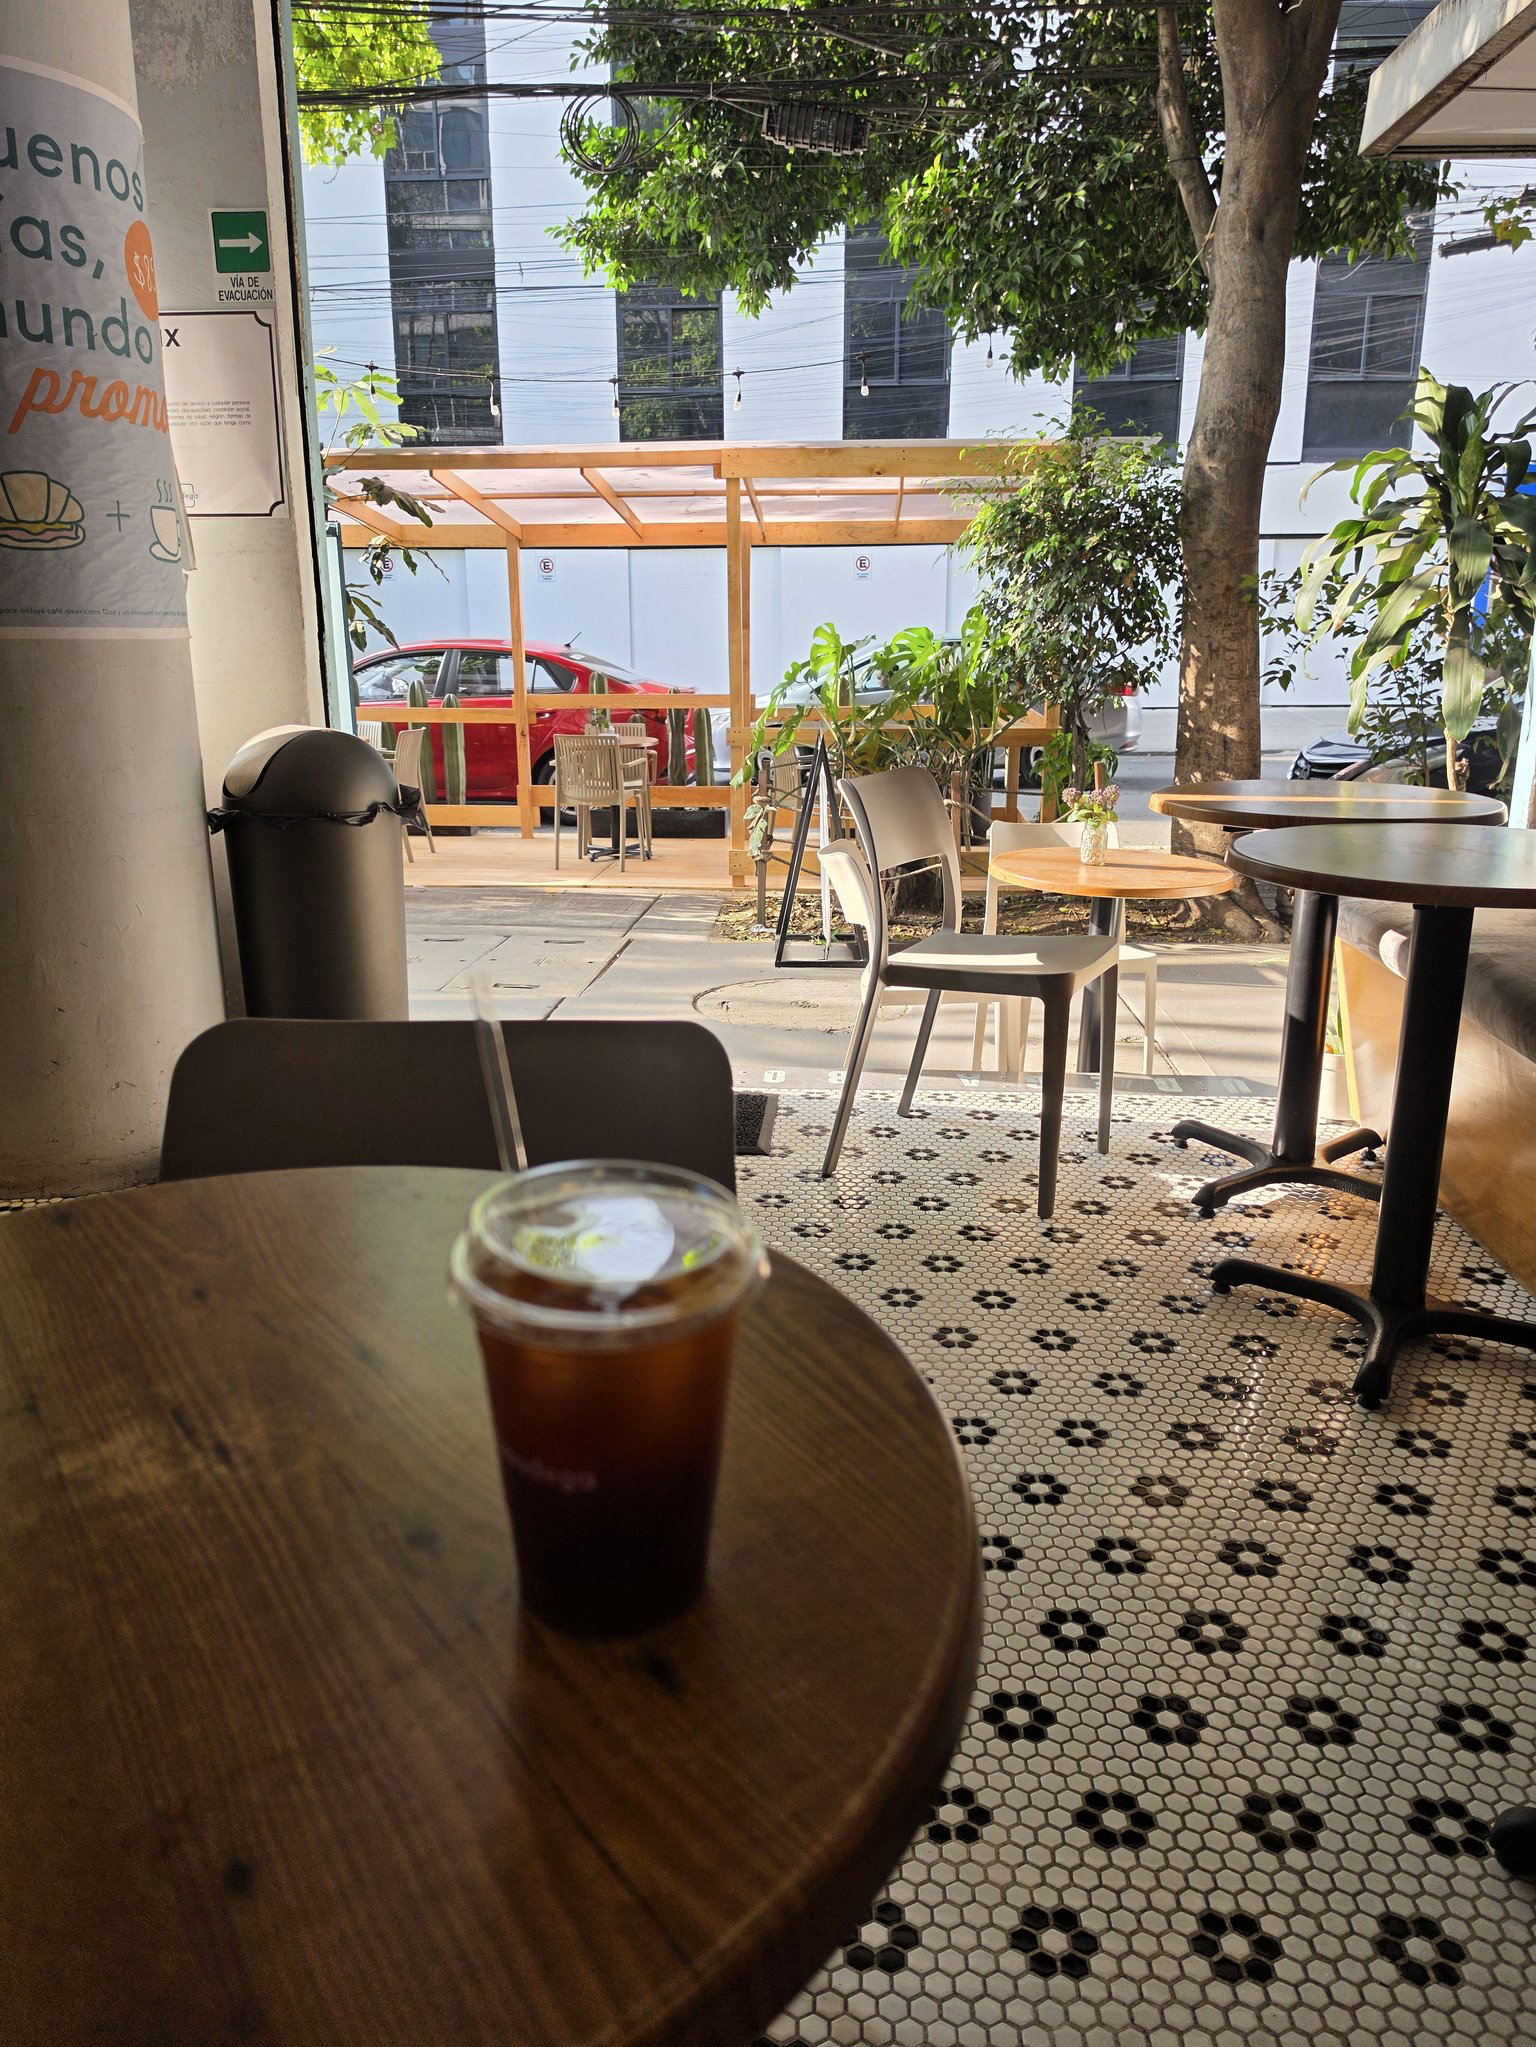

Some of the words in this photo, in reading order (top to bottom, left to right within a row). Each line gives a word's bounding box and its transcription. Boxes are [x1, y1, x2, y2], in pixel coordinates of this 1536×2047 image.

[0, 195, 104, 280] as,
[230, 273, 245, 288] VÍA
[247, 276, 260, 288] DE
[218, 286, 273, 301] EVACUACIÓN
[160, 328, 181, 348] X
[20, 607, 46, 616] incluye
[47, 607, 63, 616] café
[64, 608, 101, 616] americano
